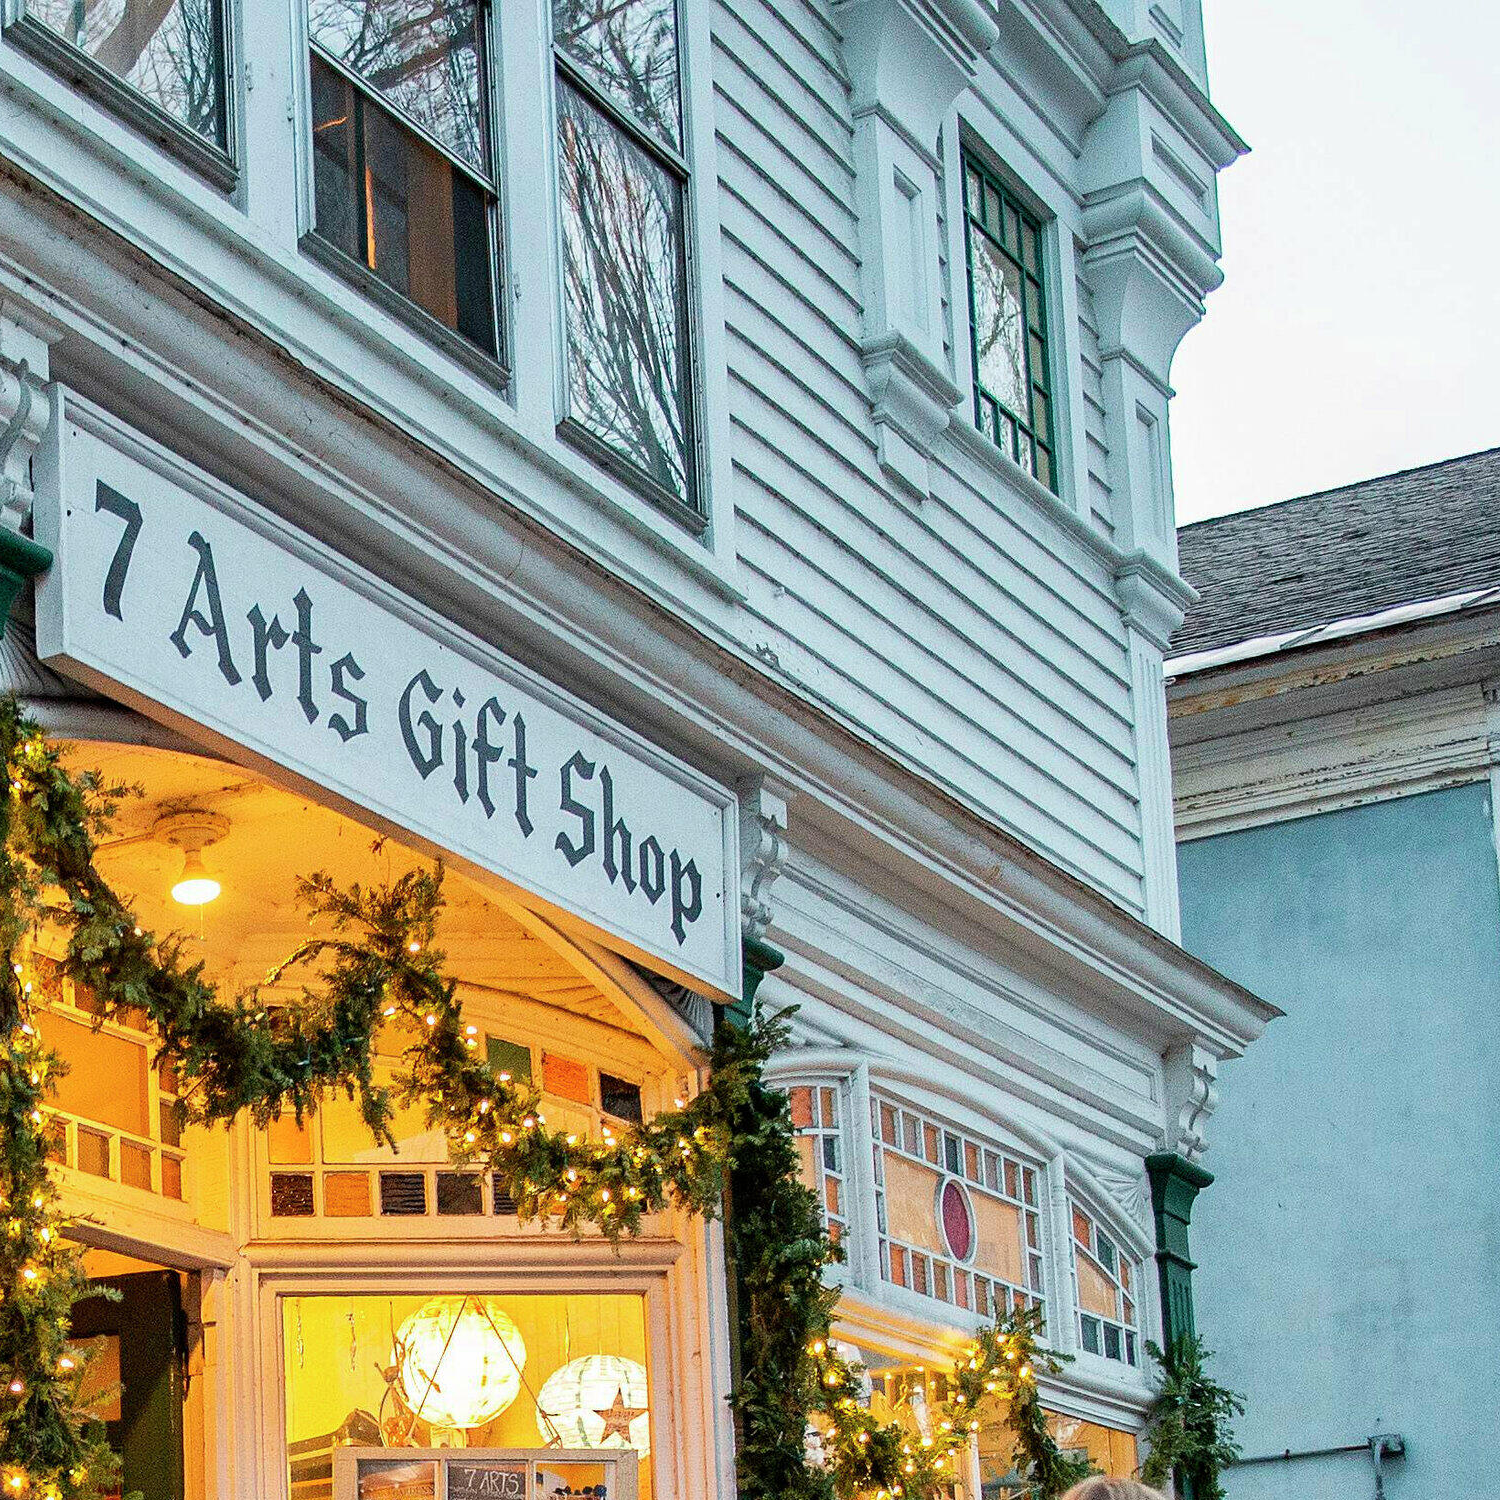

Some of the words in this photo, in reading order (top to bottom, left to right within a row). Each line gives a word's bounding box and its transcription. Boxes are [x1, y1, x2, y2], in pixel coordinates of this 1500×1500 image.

[94, 478, 144, 621] 7
[169, 530, 370, 742] Arts
[397, 667, 539, 839] Gift
[555, 749, 703, 946] Shop
[464, 1468, 476, 1487] 7
[479, 1470, 519, 1494] ARTS
